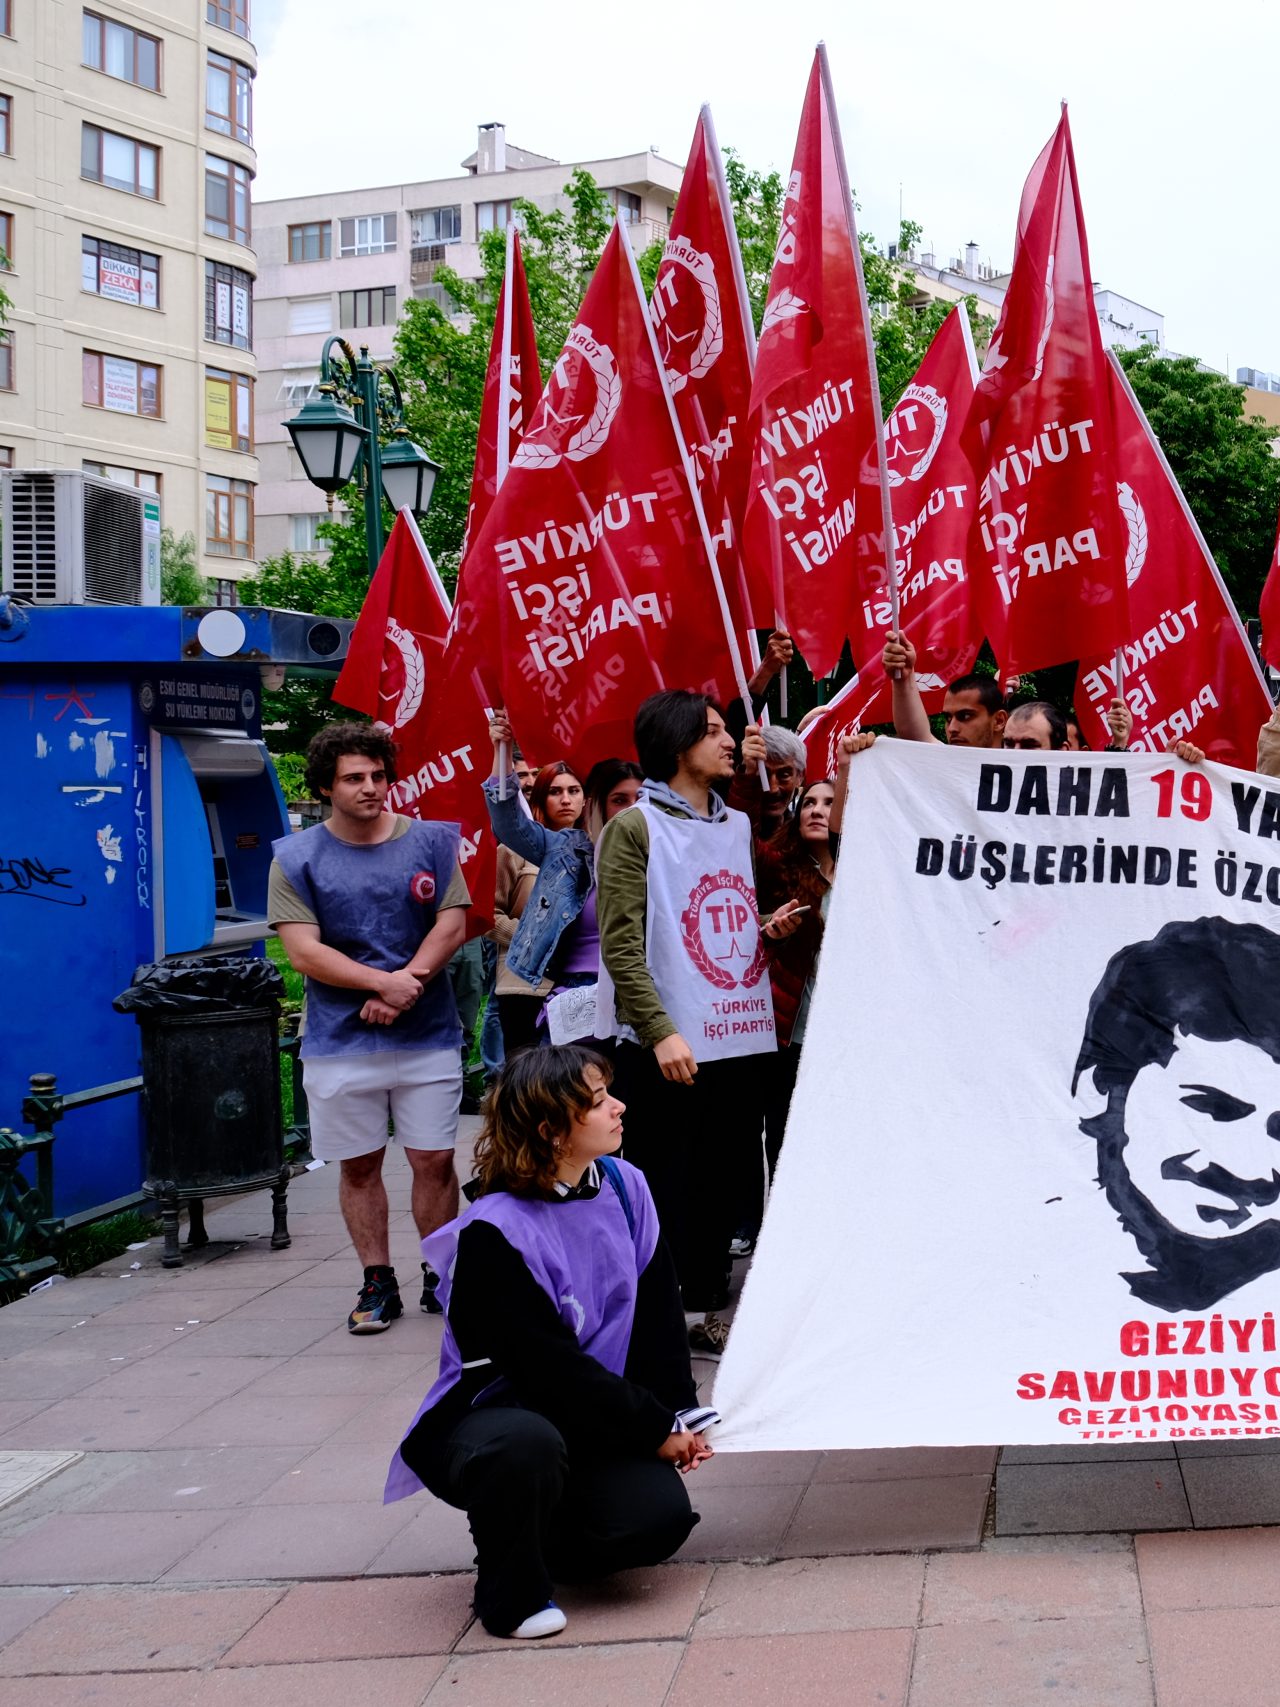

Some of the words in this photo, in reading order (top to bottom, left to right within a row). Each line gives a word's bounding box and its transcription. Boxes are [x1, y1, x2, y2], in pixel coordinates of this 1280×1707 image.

[103, 260, 137, 276] DİKKAT
[104, 273, 135, 290] ZEKA
[160, 679, 176, 695] ESKİ
[177, 681, 199, 698] GENEL
[200, 682, 240, 701] MÜDÜRLÜĞÜ
[166, 703, 175, 717] SU
[177, 701, 207, 719] YÜKLEME
[209, 705, 236, 721] NOKTASI
[976, 763, 1131, 818] DAHA
[1150, 768, 1213, 822] 19
[915, 833, 1199, 891] DÜŞLERİNDE
[690, 881, 712, 919] TÜRKİYE
[716, 875, 734, 888] İŞÇİ
[706, 897, 749, 934] TİP
[712, 996, 767, 1016] TÜRKİYE
[704, 1020, 729, 1041] İŞÇİ
[732, 1016, 775, 1036] PARTİSİ
[1120, 1311, 1277, 1358] GEZİYİ
